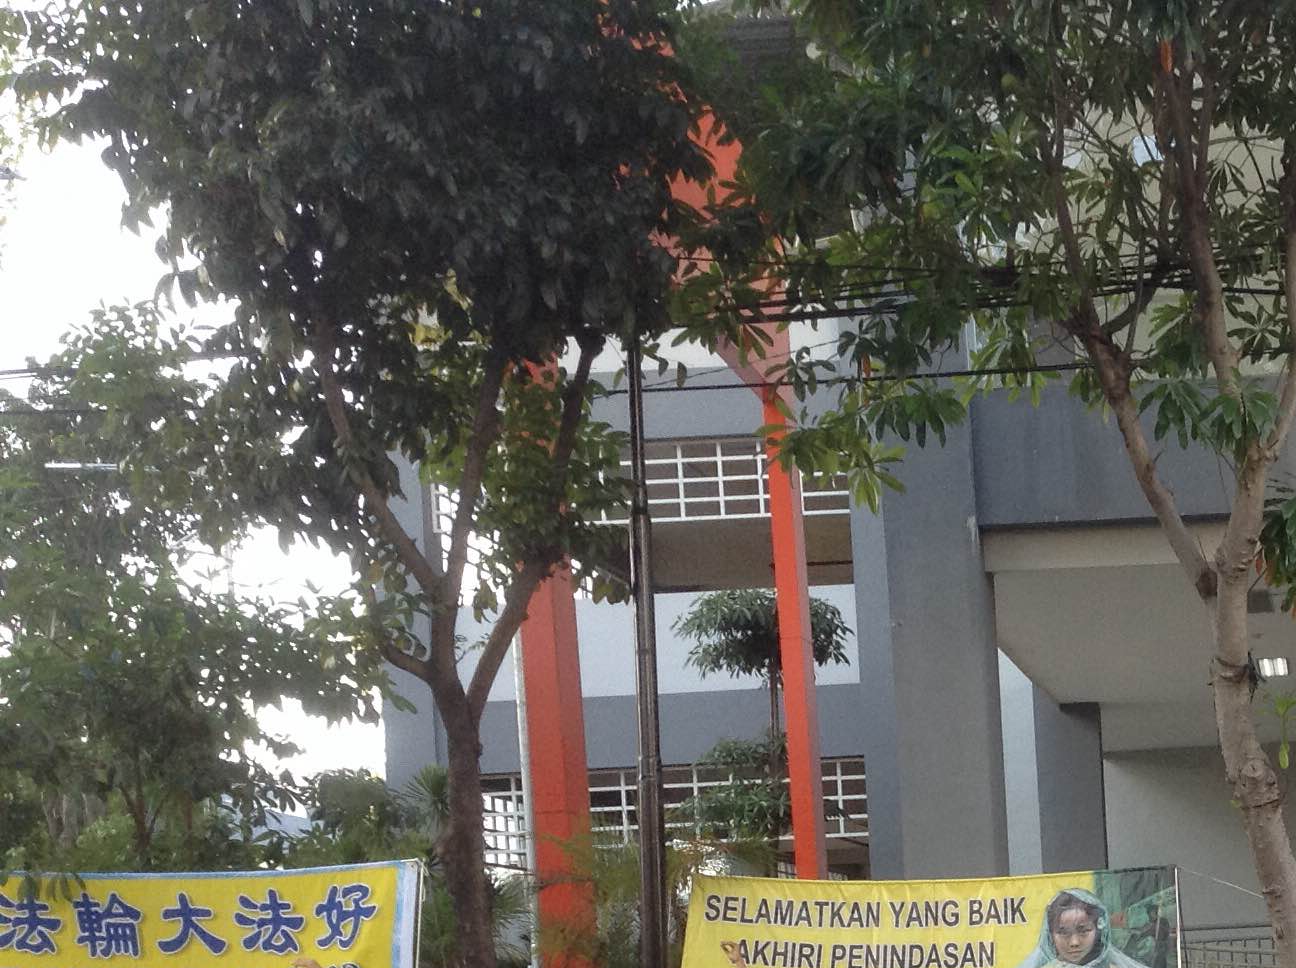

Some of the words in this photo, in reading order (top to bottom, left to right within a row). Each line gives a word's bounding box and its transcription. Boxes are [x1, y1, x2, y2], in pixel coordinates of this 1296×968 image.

[0, 883, 378, 958] 法輪大法好
[704, 894, 881, 929] SELAMATKAN
[889, 900, 960, 929] YANG
[968, 896, 1028, 926] BAIK
